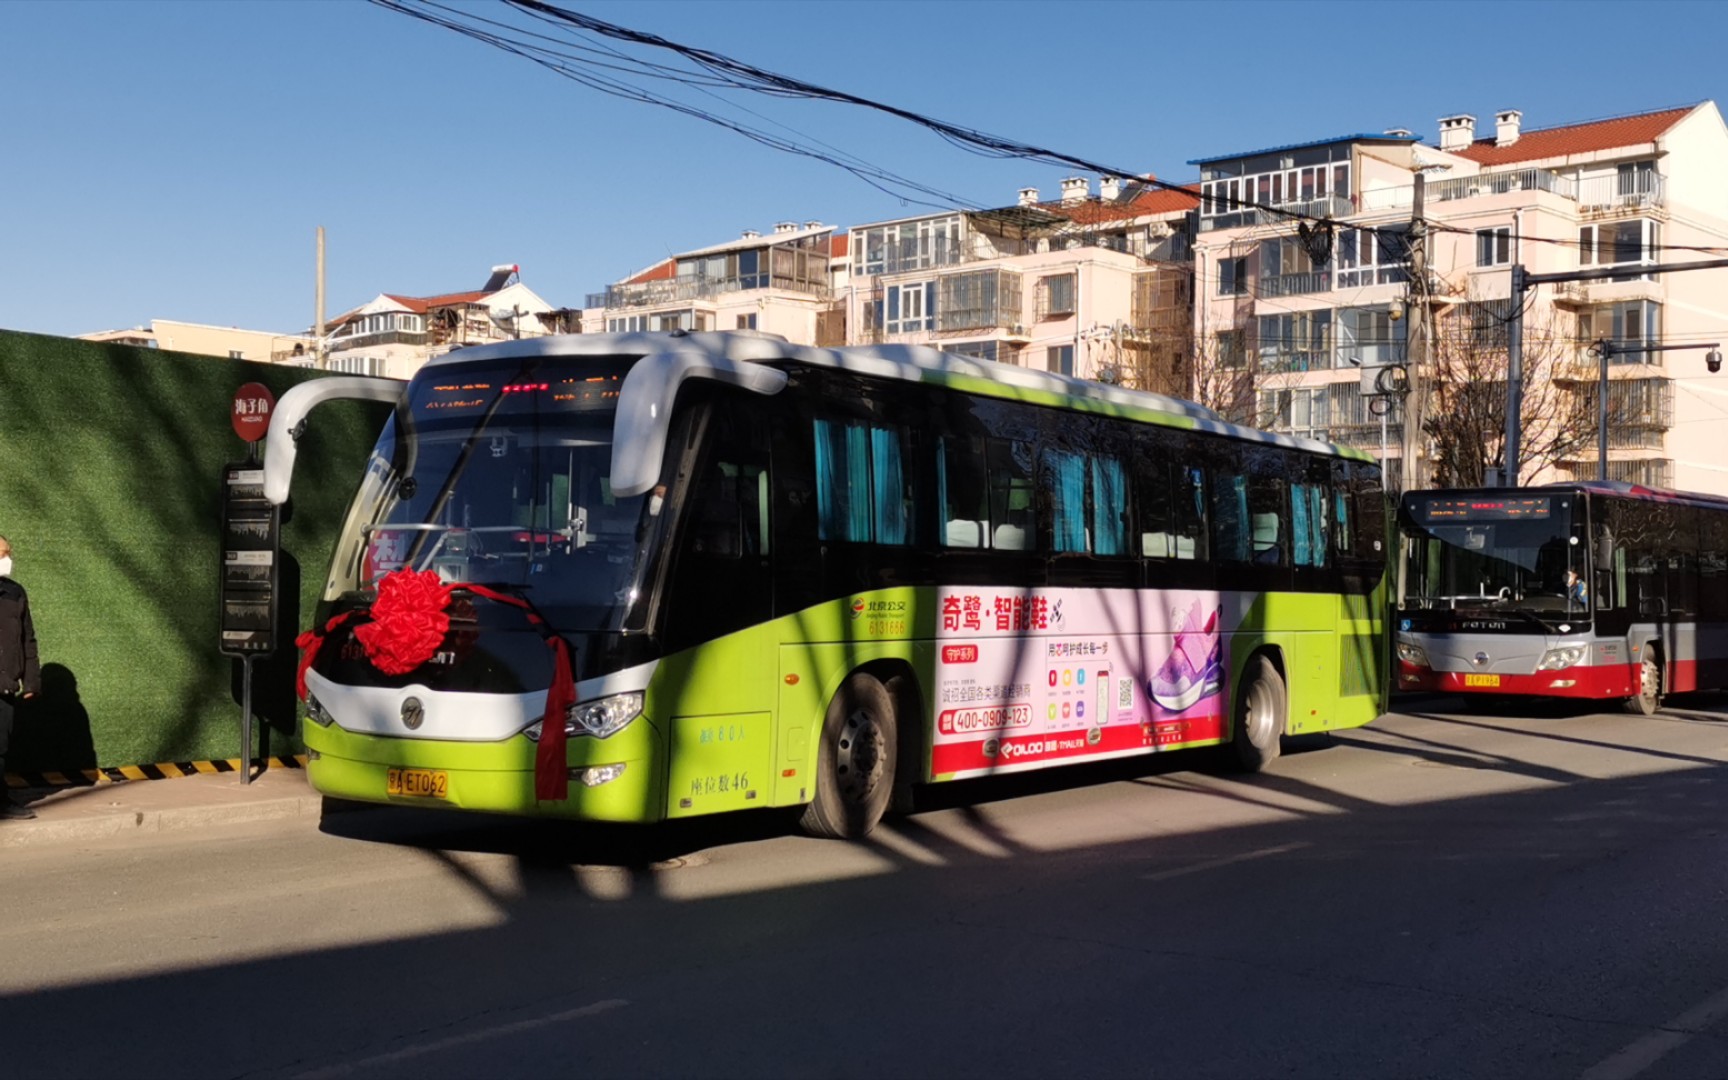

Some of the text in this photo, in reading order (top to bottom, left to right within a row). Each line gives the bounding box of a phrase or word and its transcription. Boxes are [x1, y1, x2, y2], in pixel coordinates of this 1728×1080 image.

[235, 398, 269, 415] 海子角
[867, 600, 906, 611] 北京公交
[957, 707, 1028, 729] 400-0909-123
[691, 771, 749, 796] 座位数46
